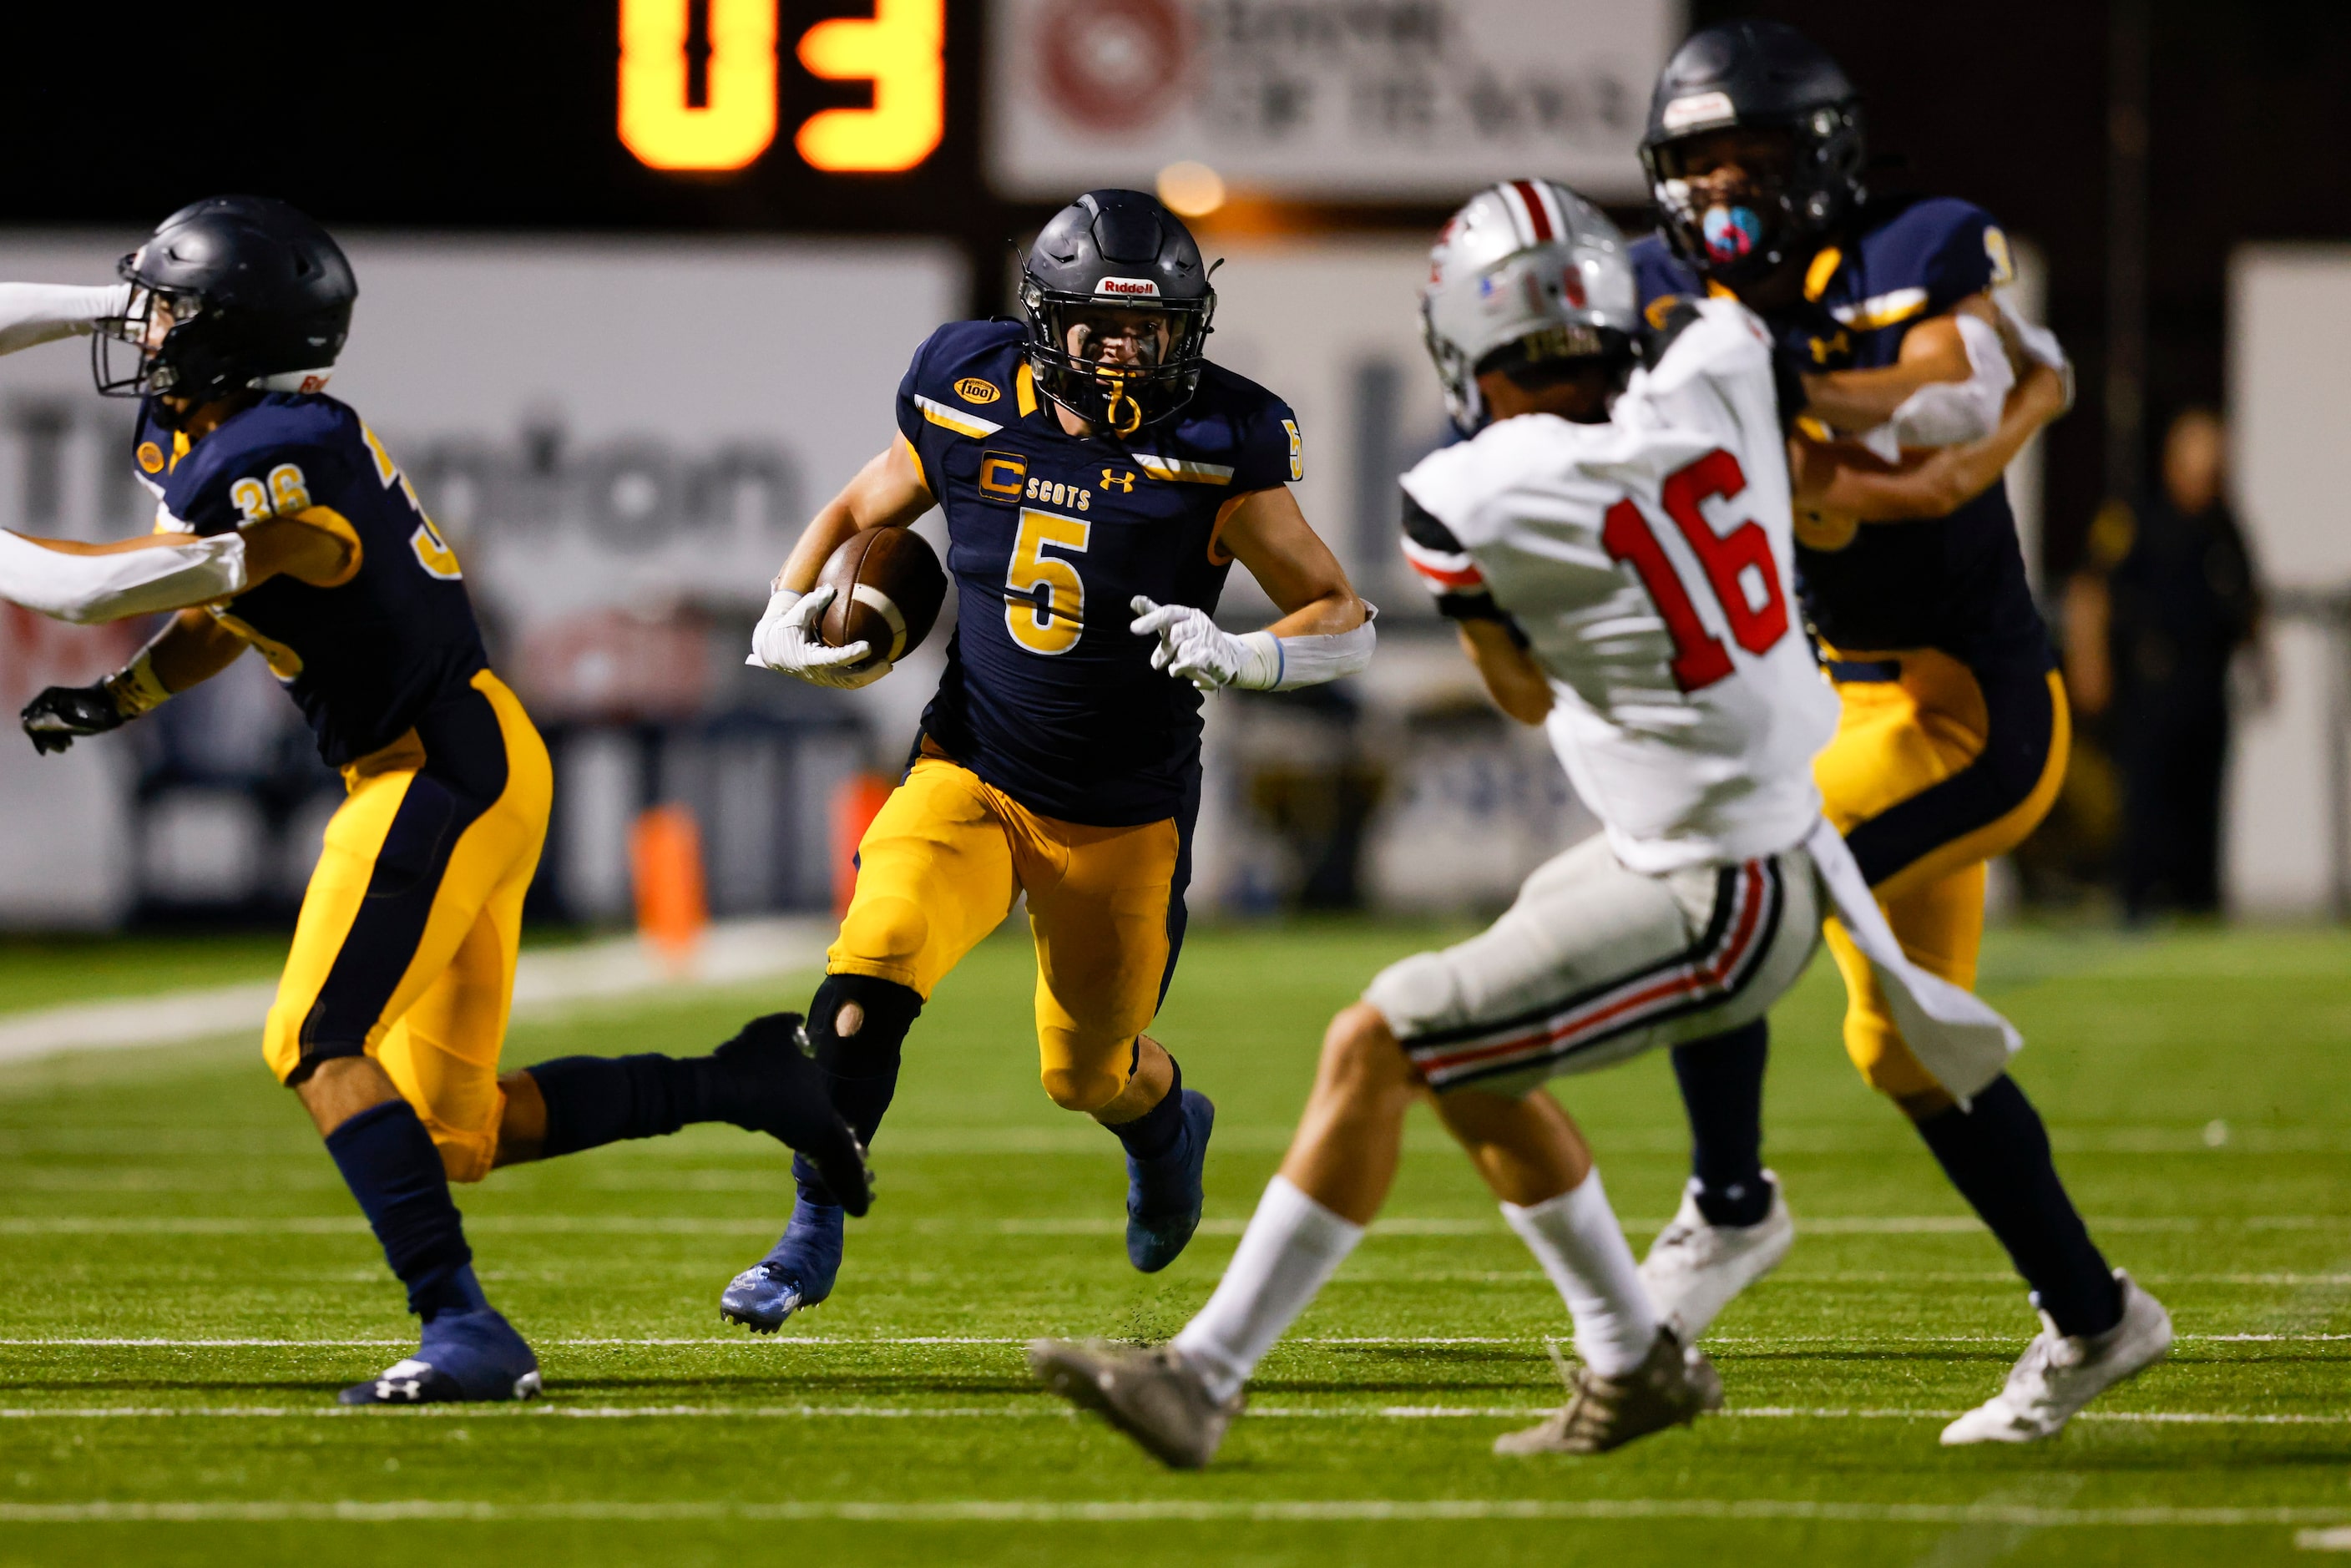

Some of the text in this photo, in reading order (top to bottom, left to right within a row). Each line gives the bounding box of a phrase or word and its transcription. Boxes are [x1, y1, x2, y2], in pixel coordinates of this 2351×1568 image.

[1105, 281, 1153, 294] Riddell
[966, 385, 988, 397] 100
[1280, 419, 1302, 480] 5
[229, 463, 312, 529] 36
[980, 458, 1026, 495] C
[1026, 477, 1091, 511] SCOTS
[1004, 507, 1092, 656] 5
[1600, 448, 1789, 694] 16
